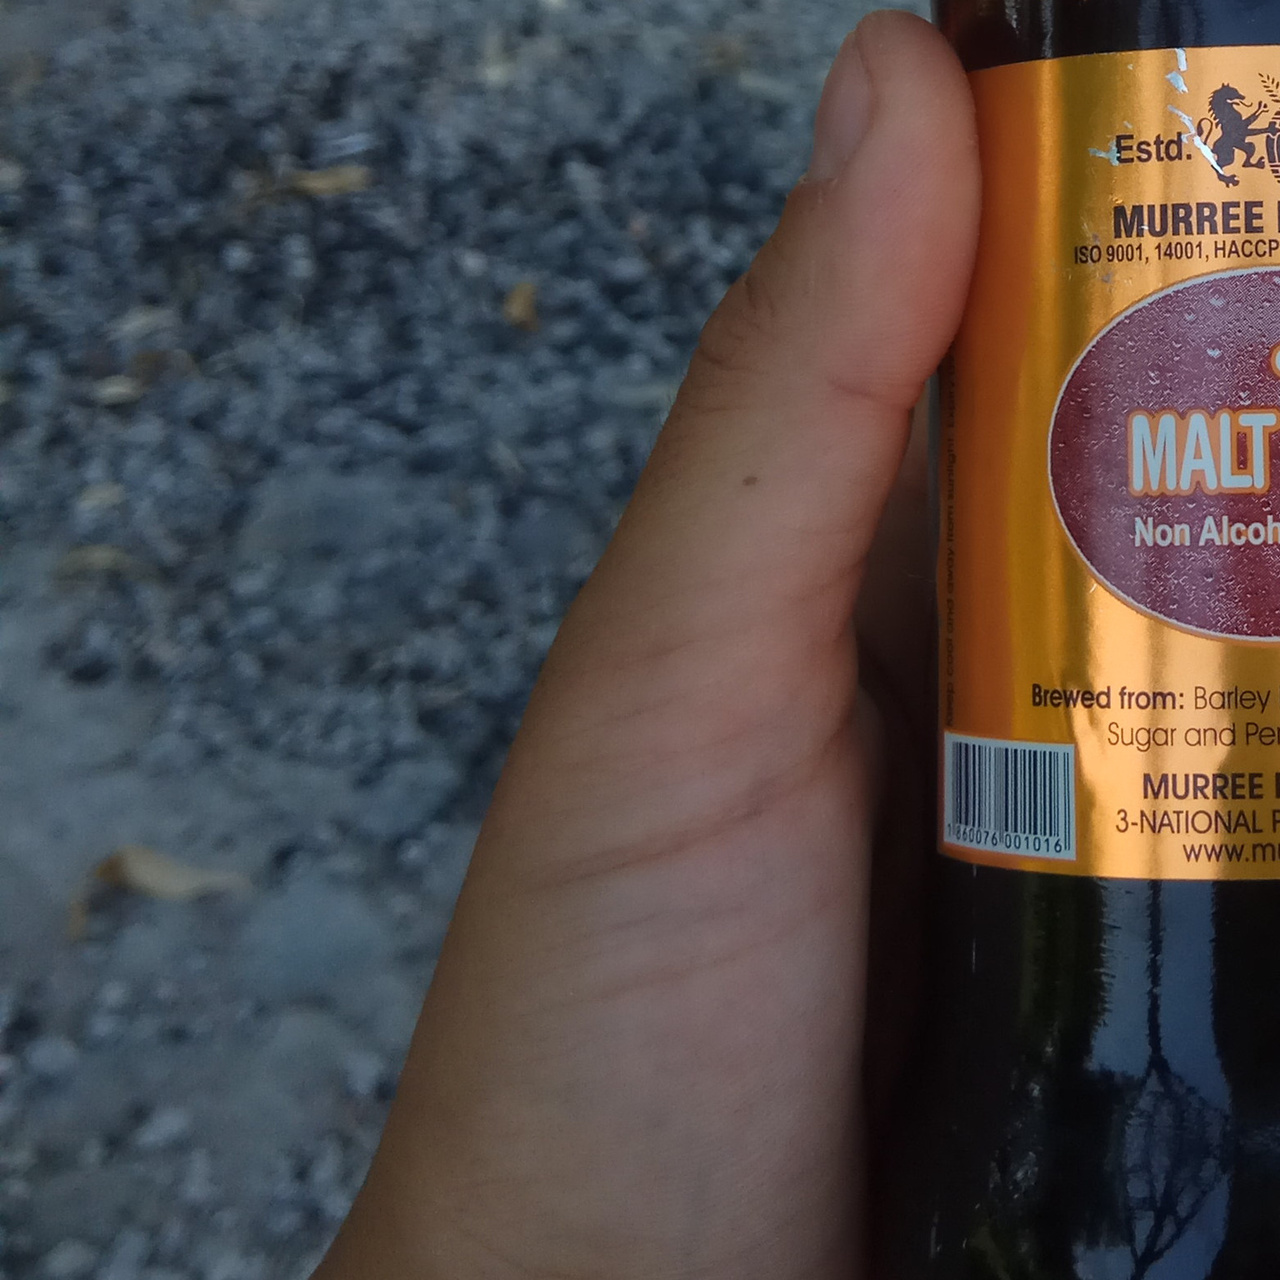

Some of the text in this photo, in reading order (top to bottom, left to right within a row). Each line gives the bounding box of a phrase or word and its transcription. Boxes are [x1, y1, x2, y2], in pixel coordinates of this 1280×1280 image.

[1115, 131, 1193, 164] Estd.
[1112, 200, 1264, 239] MURREE
[1074, 244, 1101, 264] ISO
[1106, 243, 1149, 264] 9001,
[1154, 241, 1209, 262] 14001,
[1214, 239, 1279, 258] HACCP
[1128, 411, 1280, 495] MALT
[1134, 517, 1191, 548] Non
[1031, 683, 1111, 710] Brewed
[1118, 685, 1184, 710] from:
[1194, 684, 1271, 714] Barley
[1107, 721, 1177, 752] Sugar
[1184, 722, 1236, 746] and
[1142, 772, 1264, 800] MURREE
[1115, 808, 1263, 834] 3-NATIONAL
